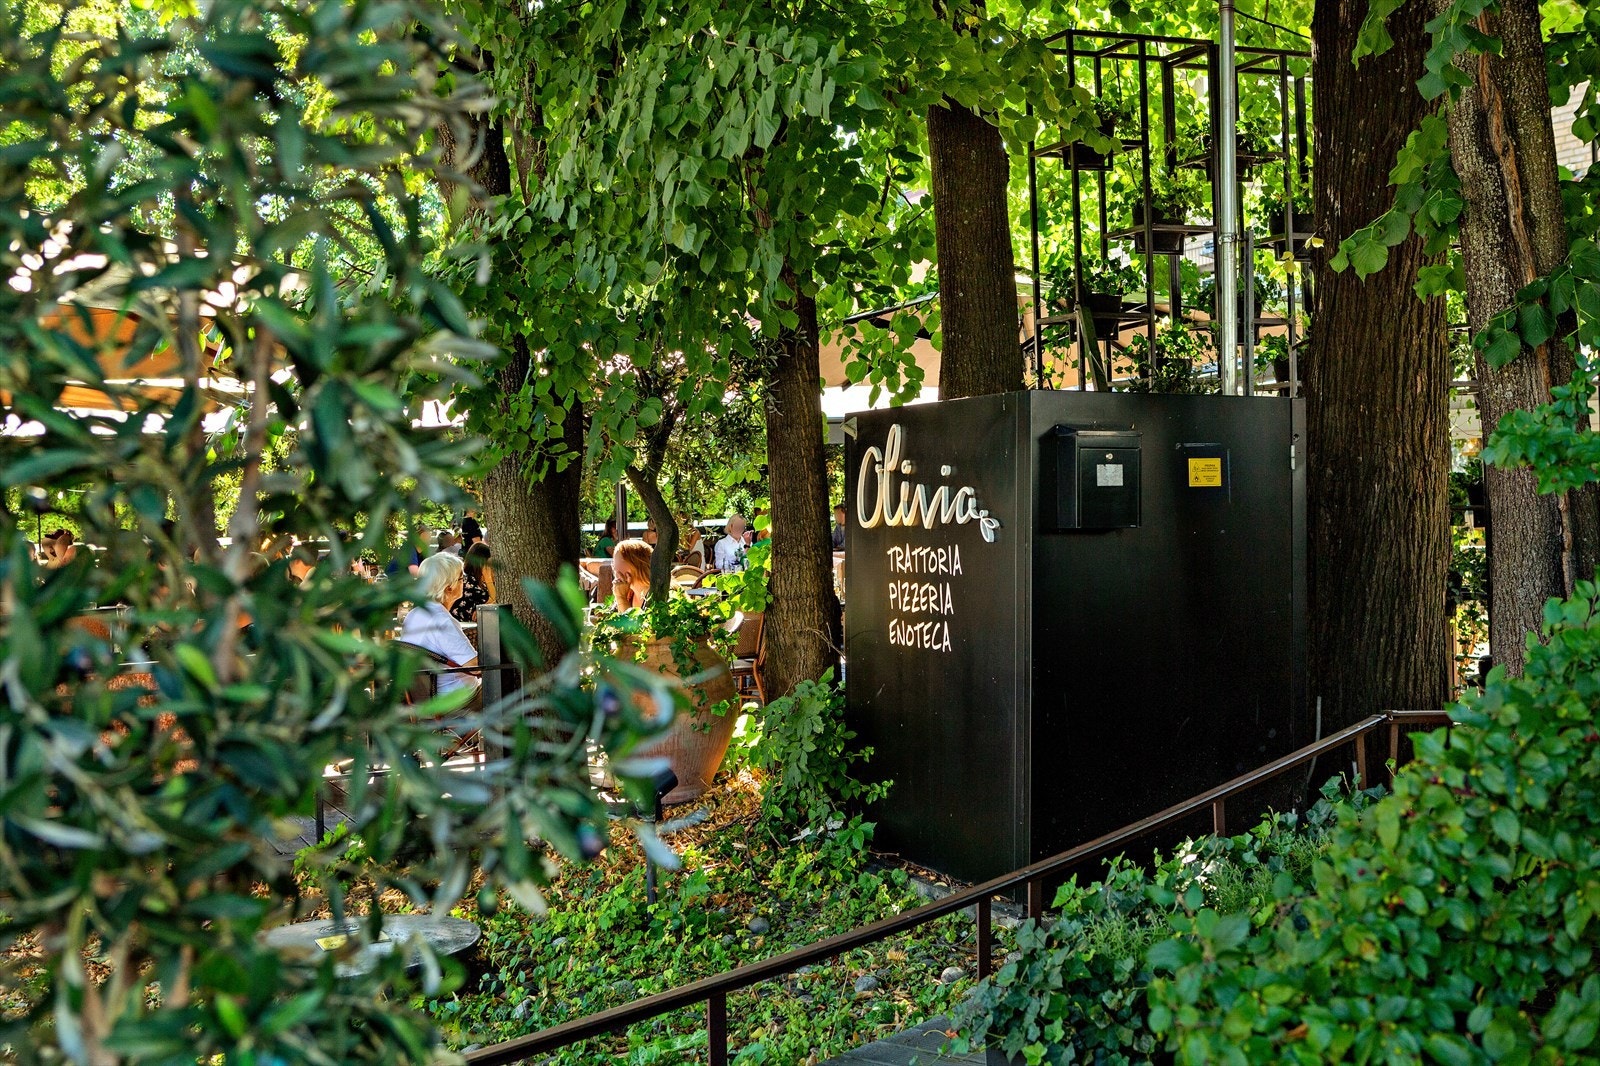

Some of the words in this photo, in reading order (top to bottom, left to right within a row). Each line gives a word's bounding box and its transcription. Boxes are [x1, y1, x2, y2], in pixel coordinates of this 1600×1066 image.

[857, 424, 978, 530] Olivia
[887, 543, 962, 576] TRATTORIA
[889, 580, 954, 615] PIZZERIA
[889, 618, 952, 652] ENOTECA
